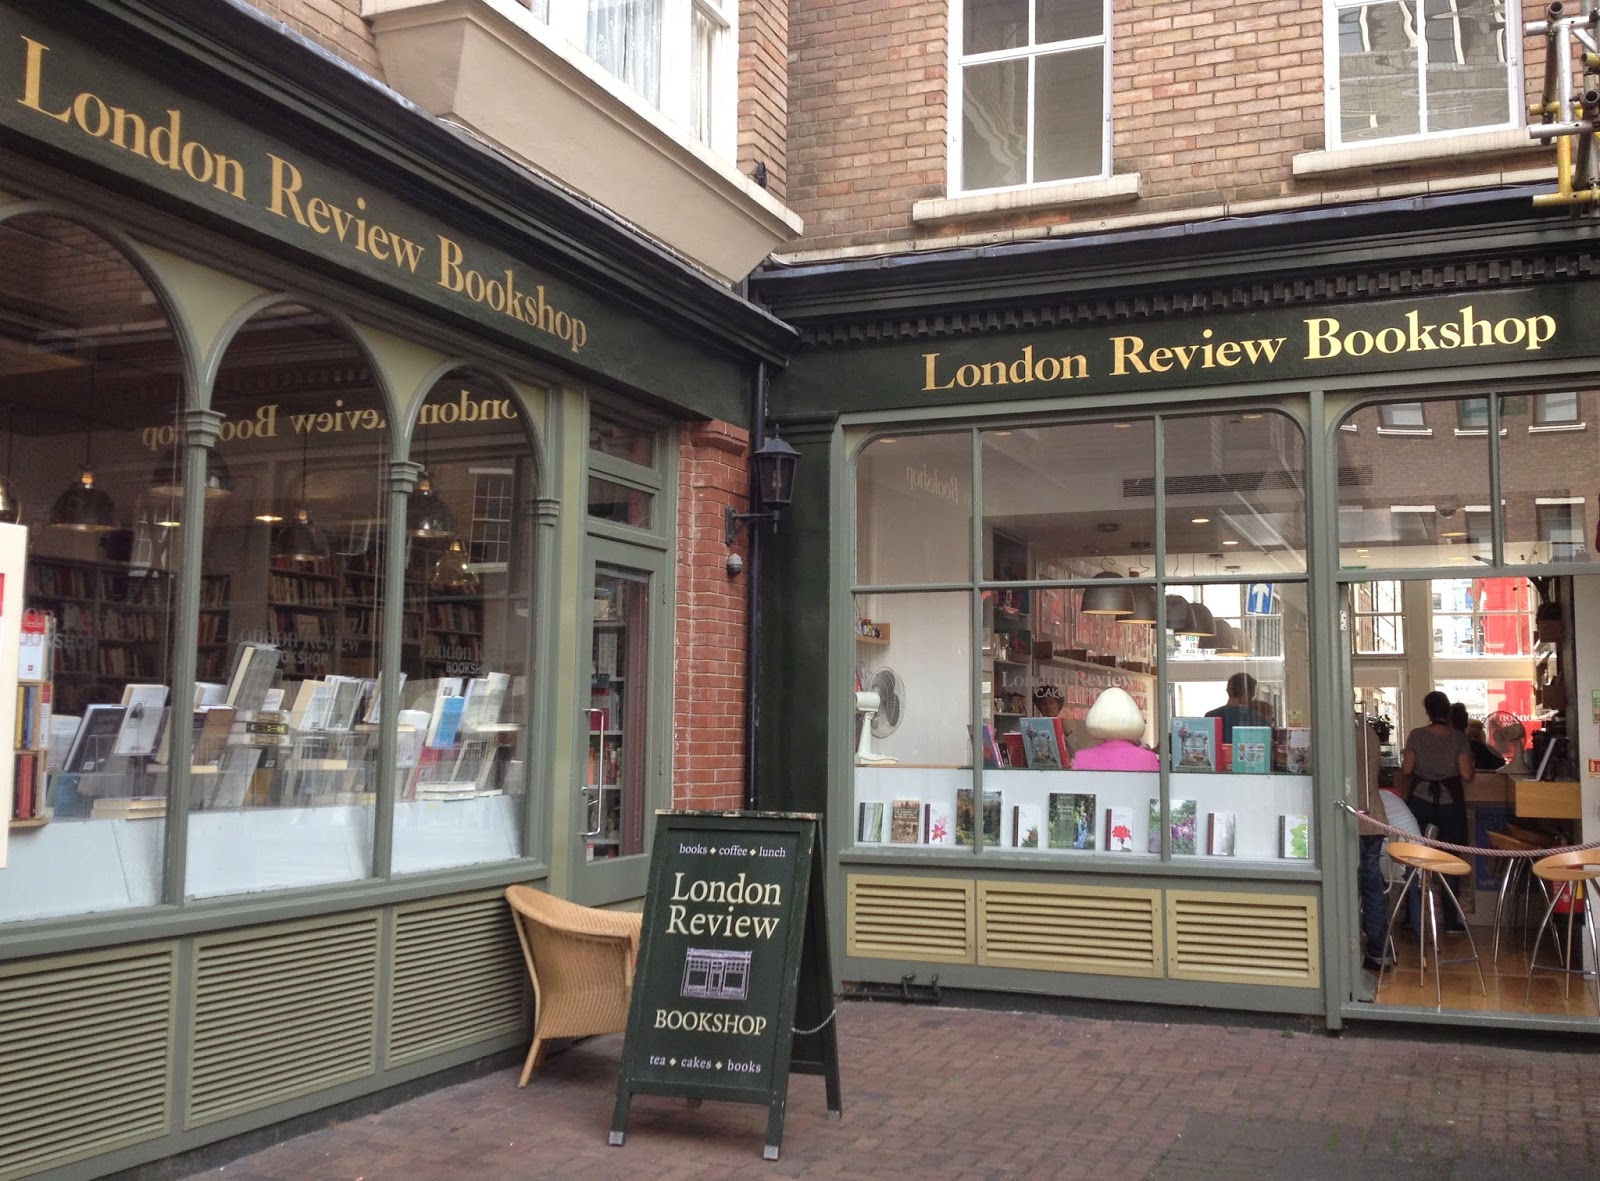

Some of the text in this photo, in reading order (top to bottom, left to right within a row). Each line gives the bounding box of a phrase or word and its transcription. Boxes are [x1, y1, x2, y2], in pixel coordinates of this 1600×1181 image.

[16, 36, 588, 353] London Review Bookshop
[921, 304, 1558, 392] London Review Bookshop
[679, 842, 786, 857] books coffee lunch
[669, 872, 782, 906] London
[665, 905, 780, 940] Review
[653, 1009, 767, 1036] BOOKSHOP
[649, 1055, 762, 1074] tea cakes books
